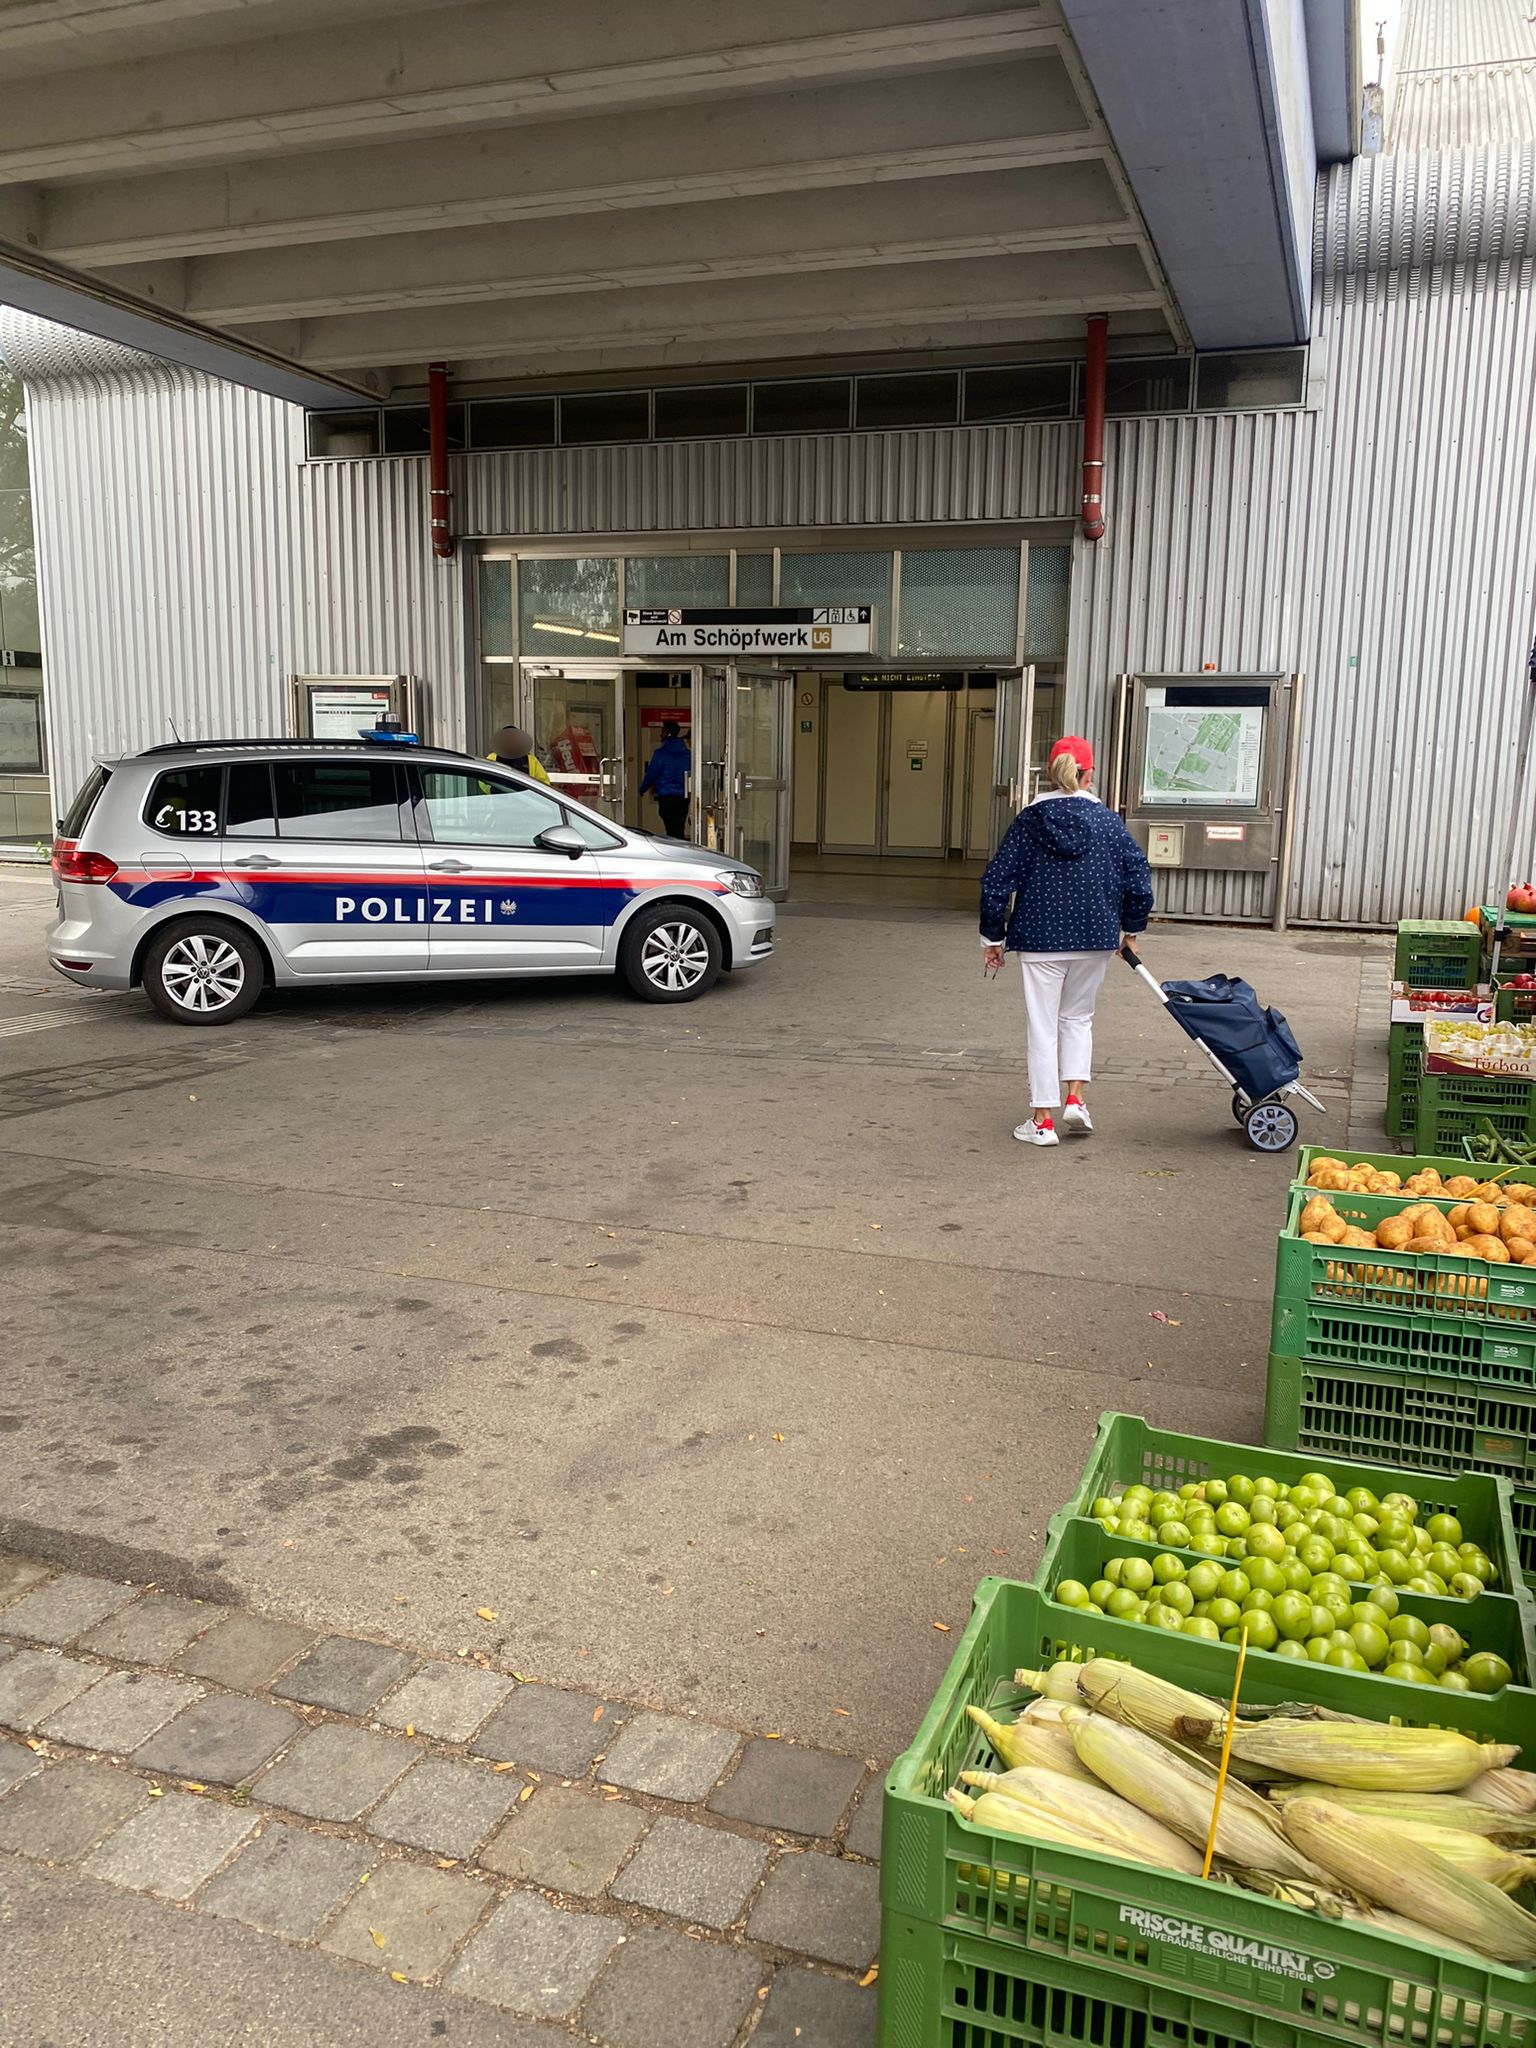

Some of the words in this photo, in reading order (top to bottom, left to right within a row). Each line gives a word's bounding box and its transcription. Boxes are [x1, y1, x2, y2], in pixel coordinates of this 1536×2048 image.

[656, 628, 687, 646] Am
[694, 628, 808, 650] Schöpfwerk
[813, 632, 830, 644] U6
[175, 809, 217, 832] 133
[335, 896, 493, 923] POLIZEI
[1472, 1057, 1530, 1072] Türkan
[1120, 1904, 1204, 1943] FRISCHE
[1207, 1931, 1310, 1972] QUALITÄT
[1251, 1959, 1315, 1983] LEIHSTEIGE
